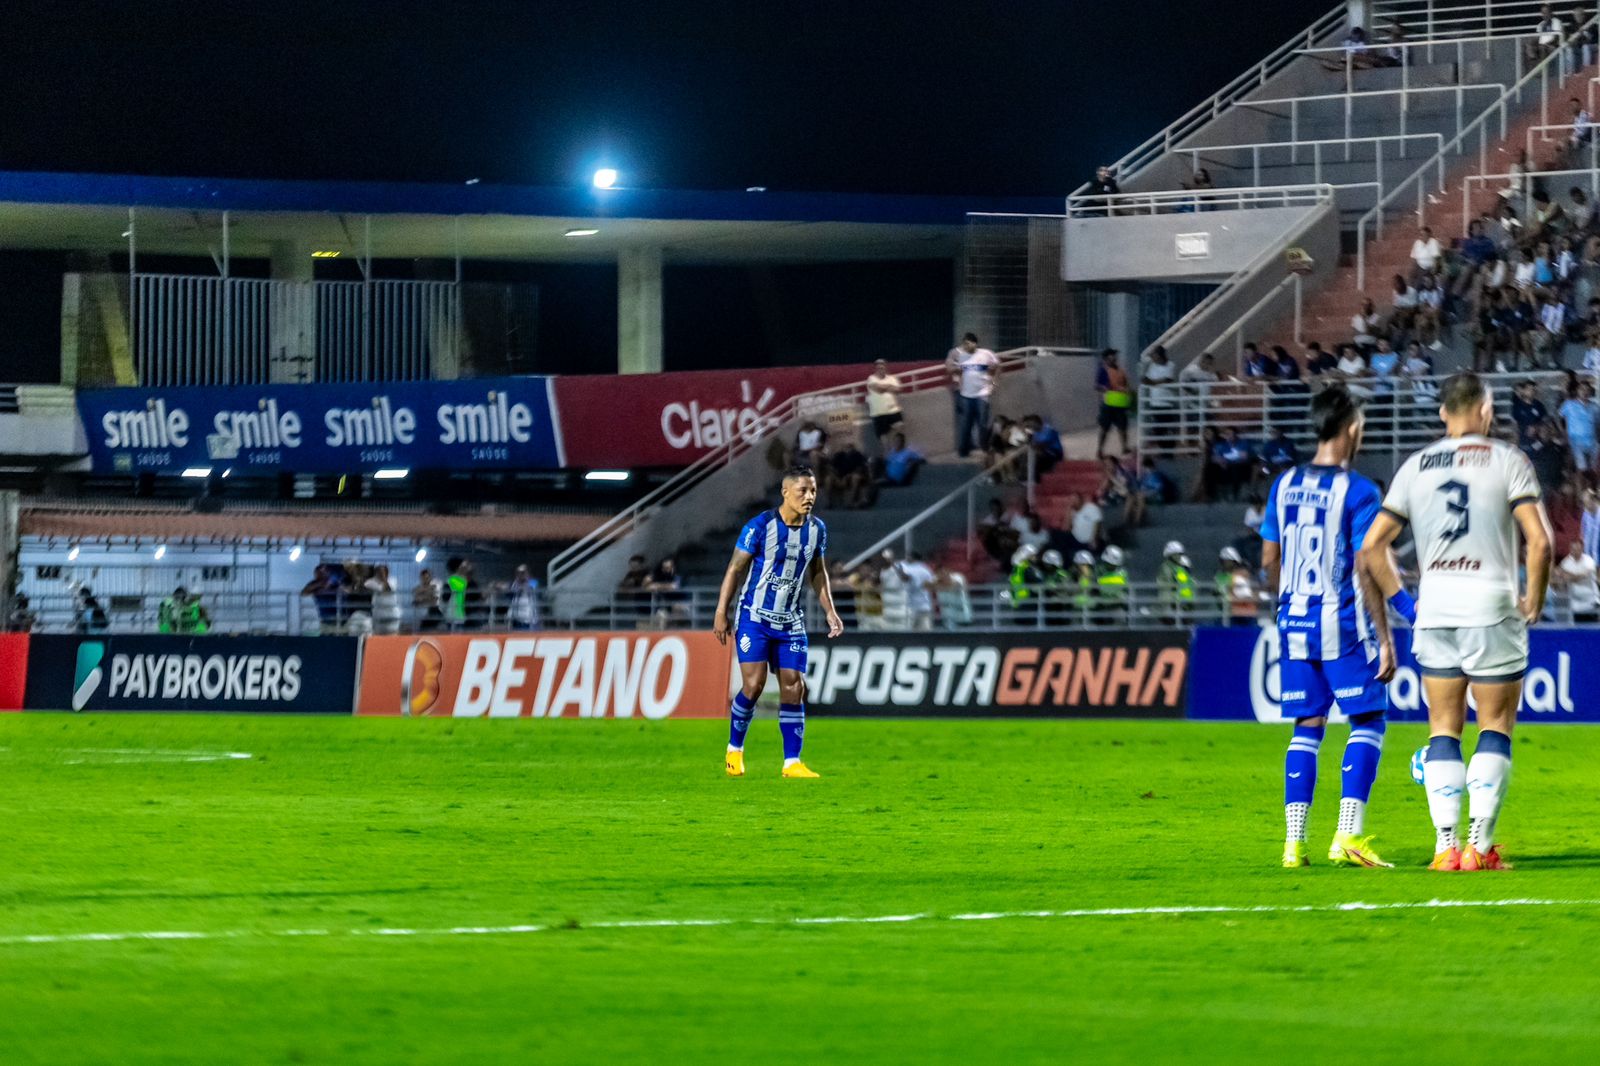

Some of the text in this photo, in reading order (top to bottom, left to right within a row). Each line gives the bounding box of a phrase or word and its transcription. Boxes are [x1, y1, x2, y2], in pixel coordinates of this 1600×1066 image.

[102, 398, 190, 448] smile
[213, 398, 301, 448] smile
[324, 395, 416, 447] smile
[437, 390, 532, 444] smile
[661, 399, 762, 449] Claro
[1437, 478, 1470, 543] 3
[1282, 522, 1325, 596] 18
[108, 653, 302, 701] PAYBROKERS
[452, 635, 690, 719] BETANO
